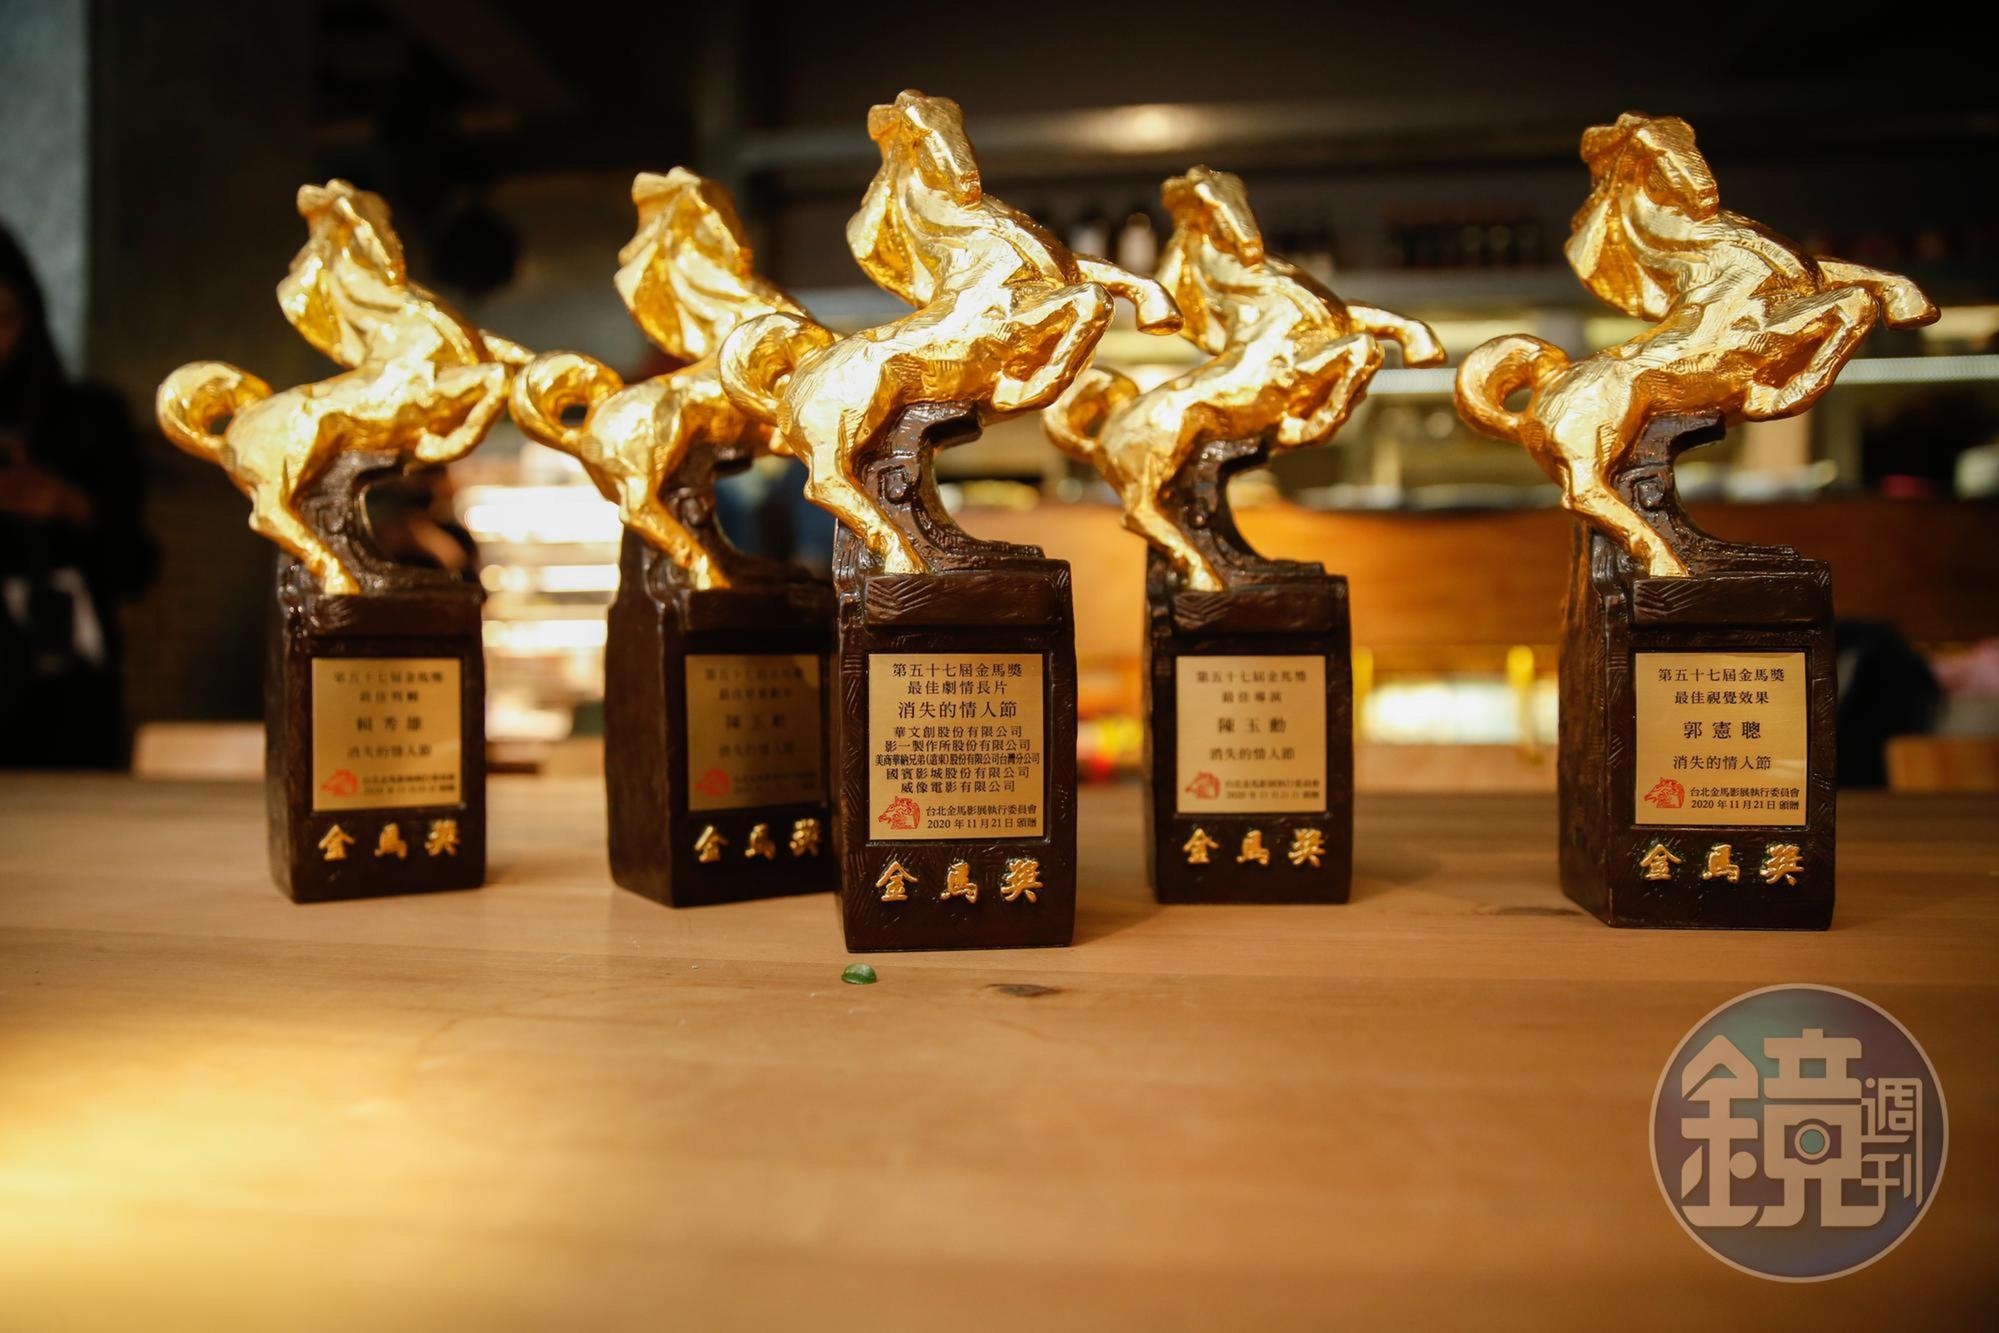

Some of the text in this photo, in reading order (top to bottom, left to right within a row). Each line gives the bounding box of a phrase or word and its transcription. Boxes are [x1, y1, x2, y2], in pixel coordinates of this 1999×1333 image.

[907, 681, 1007, 695] 最佳劇情長片
[1674, 691, 1769, 705] 最佳視覺效果
[899, 701, 1017, 719] 消失的情人節
[894, 726, 1022, 738] 華文創股份有限公司
[1683, 721, 1761, 740] 郭憲聰
[885, 740, 1031, 752] 影一製作所股份有限公司
[1673, 755, 1771, 770] 消失的情人節
[886, 767, 1029, 780] 國賓影城股份有限公司
[901, 781, 1015, 793] 威像電影有限公司
[1690, 787, 1800, 798] 台北金馬影展執行委員會
[926, 804, 1037, 817] 台北金馬影展執行委員會
